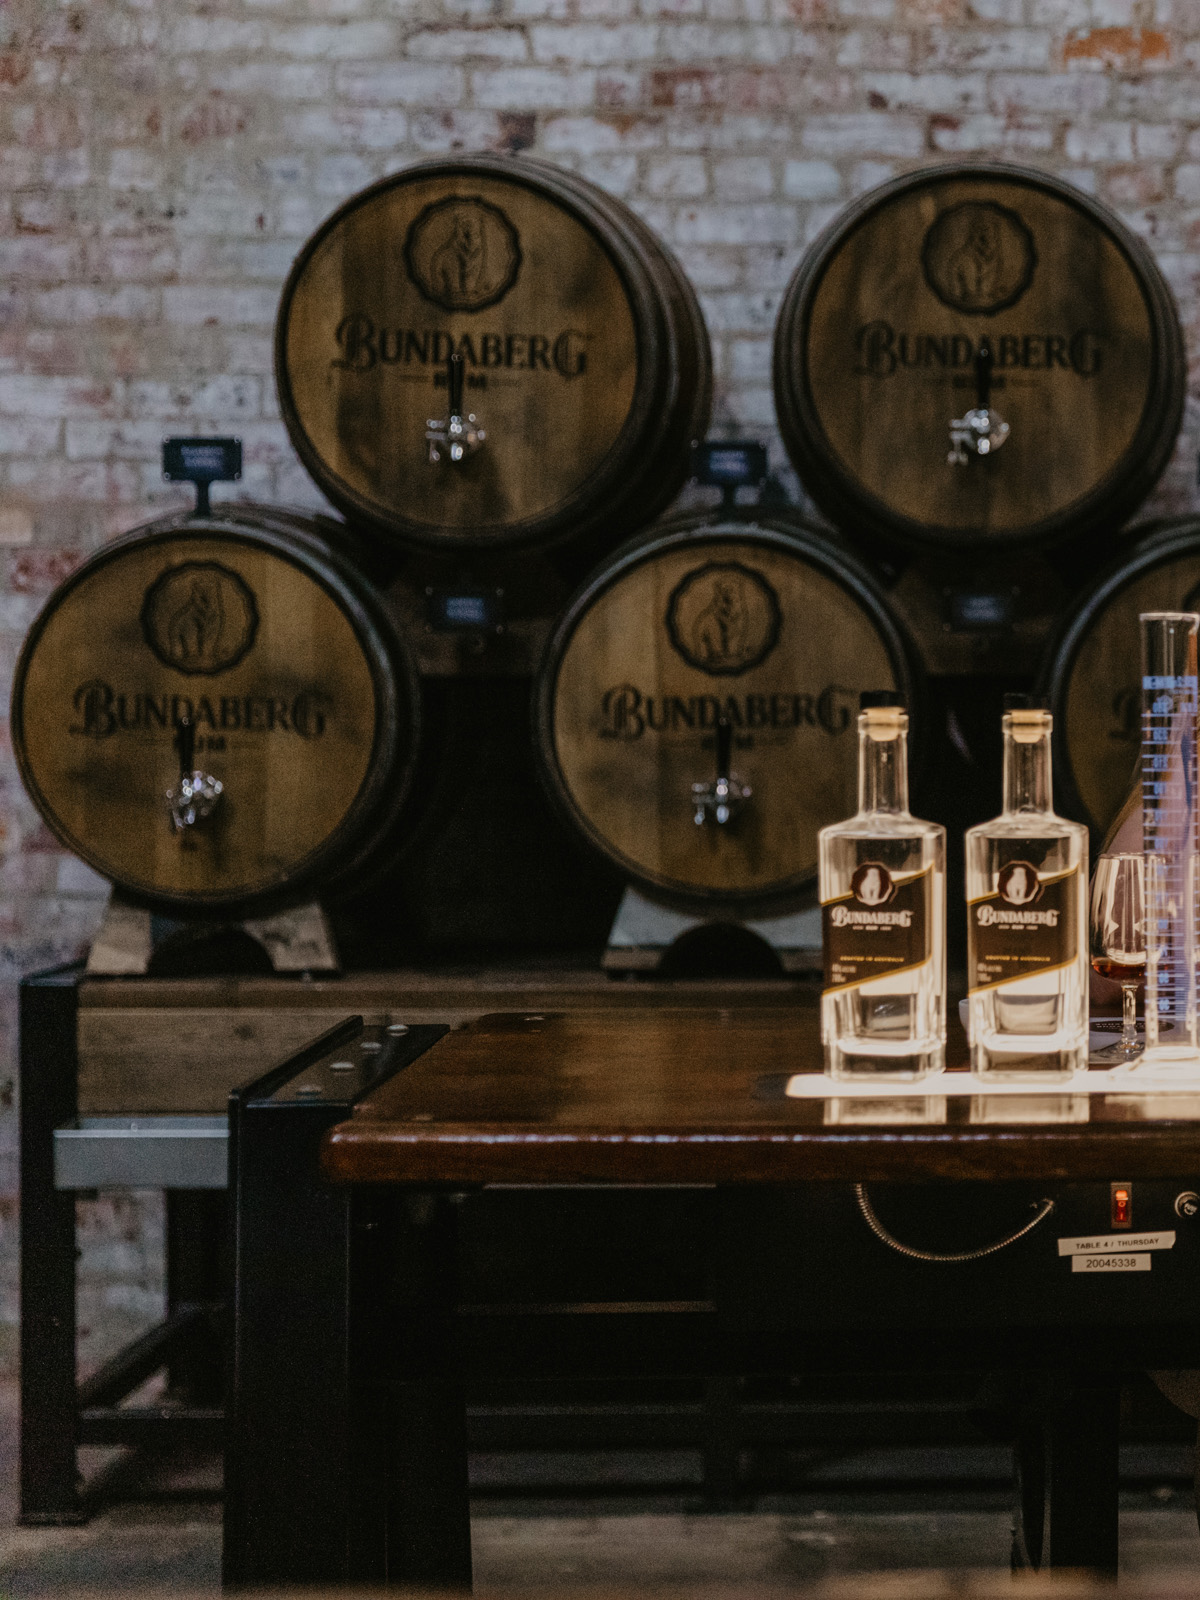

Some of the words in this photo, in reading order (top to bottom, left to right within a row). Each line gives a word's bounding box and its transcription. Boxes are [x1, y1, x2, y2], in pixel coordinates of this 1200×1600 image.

[330, 311, 590, 379] BUNDABERG
[854, 319, 1111, 378] BUNDABERG
[68, 678, 332, 741] BUNDABERG
[598, 684, 857, 741] BUNDABERG
[831, 905, 914, 928] BUNDABERG
[976, 904, 1061, 927] BUNDABERG
[1076, 1242, 1101, 1250] TABLE
[1118, 1238, 1160, 1247] THURSDAY
[1086, 1258, 1137, 1269] 20045338
